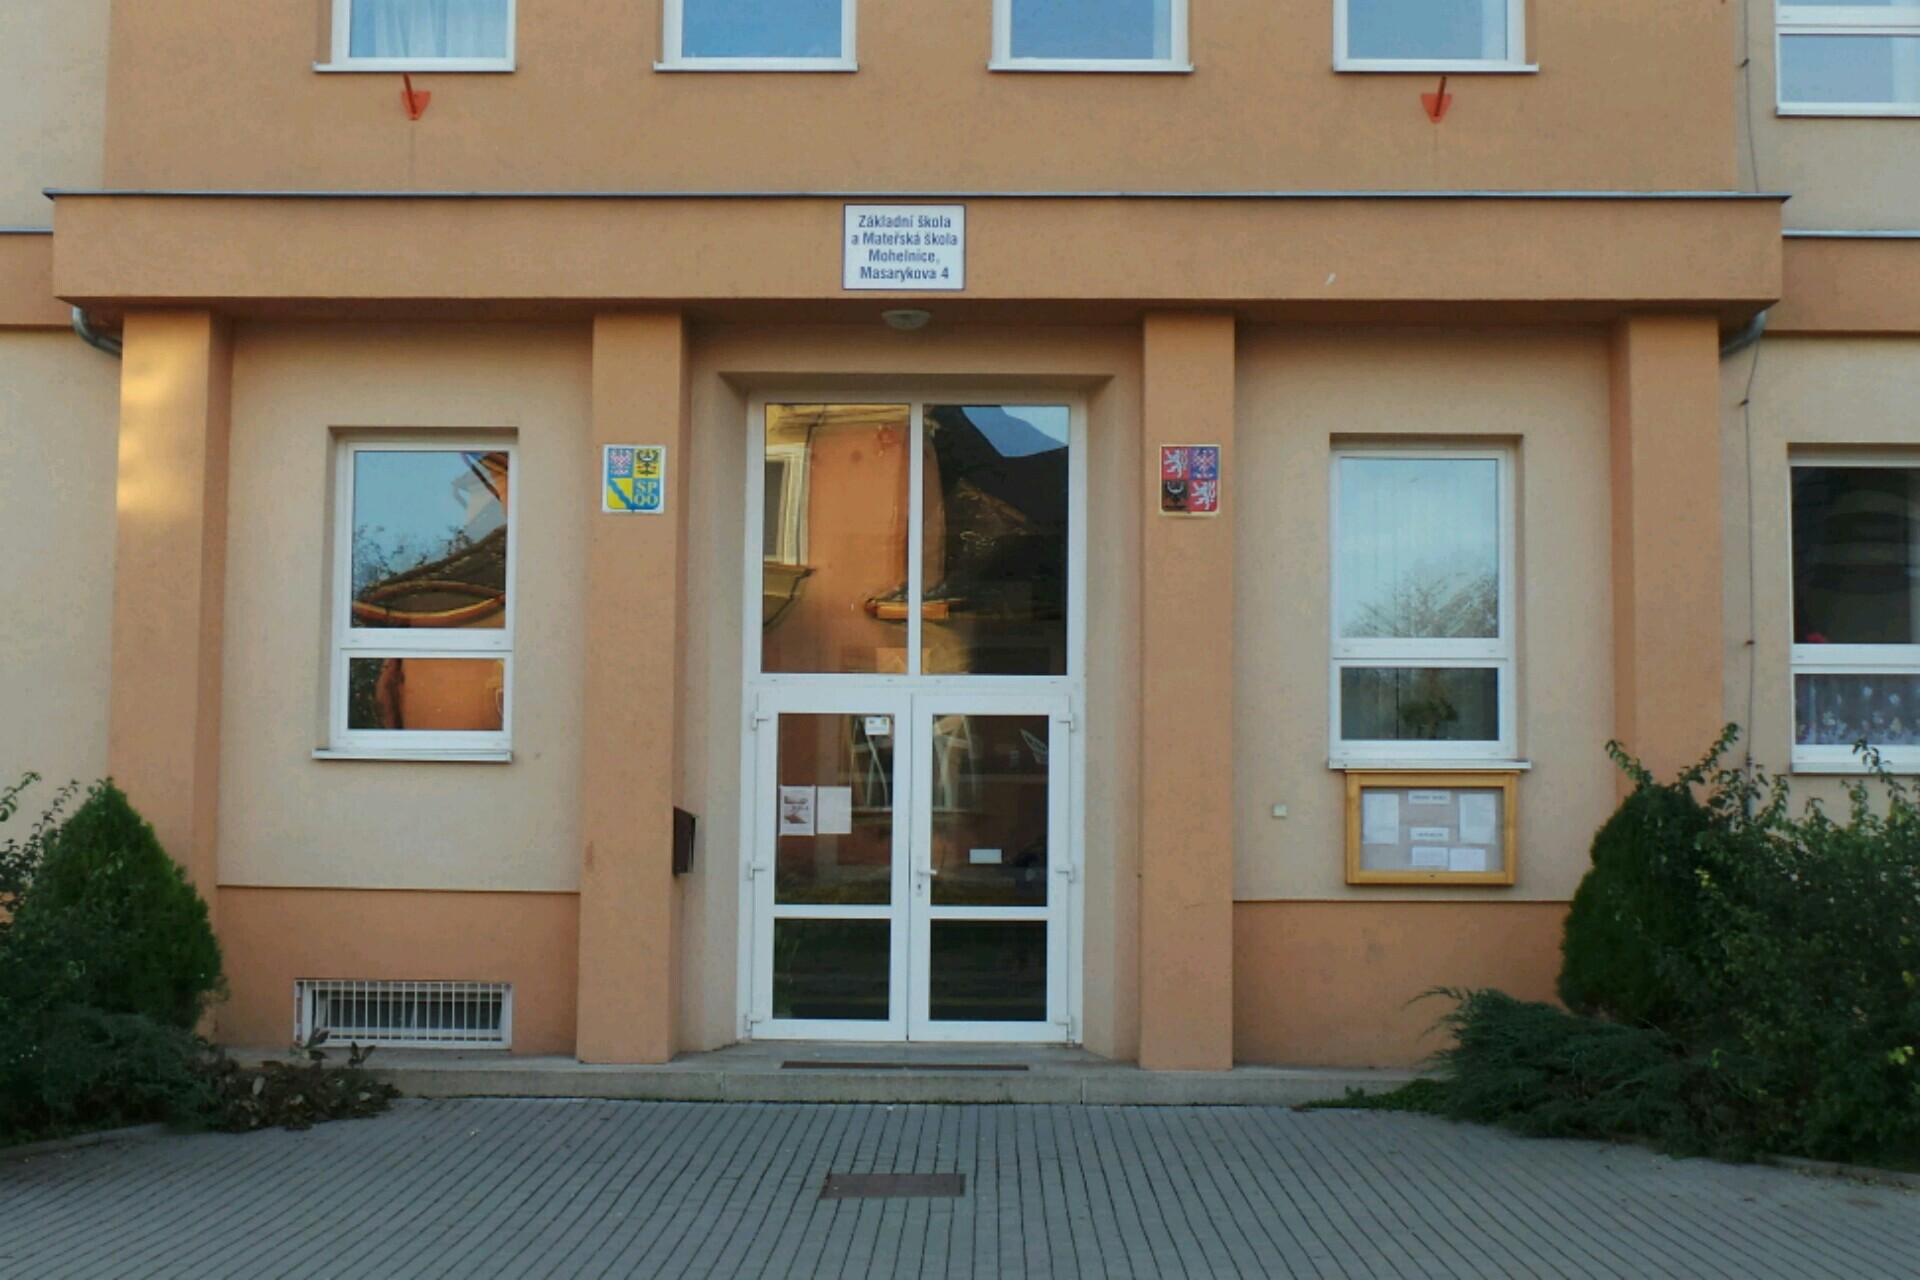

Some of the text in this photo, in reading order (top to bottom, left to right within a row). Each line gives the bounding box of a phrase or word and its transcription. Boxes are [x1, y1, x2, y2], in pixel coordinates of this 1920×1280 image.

[858, 215, 951, 228] Základní škola
[851, 231, 957, 245] a Mateřská škola
[860, 266, 949, 283] Masarykova 4
